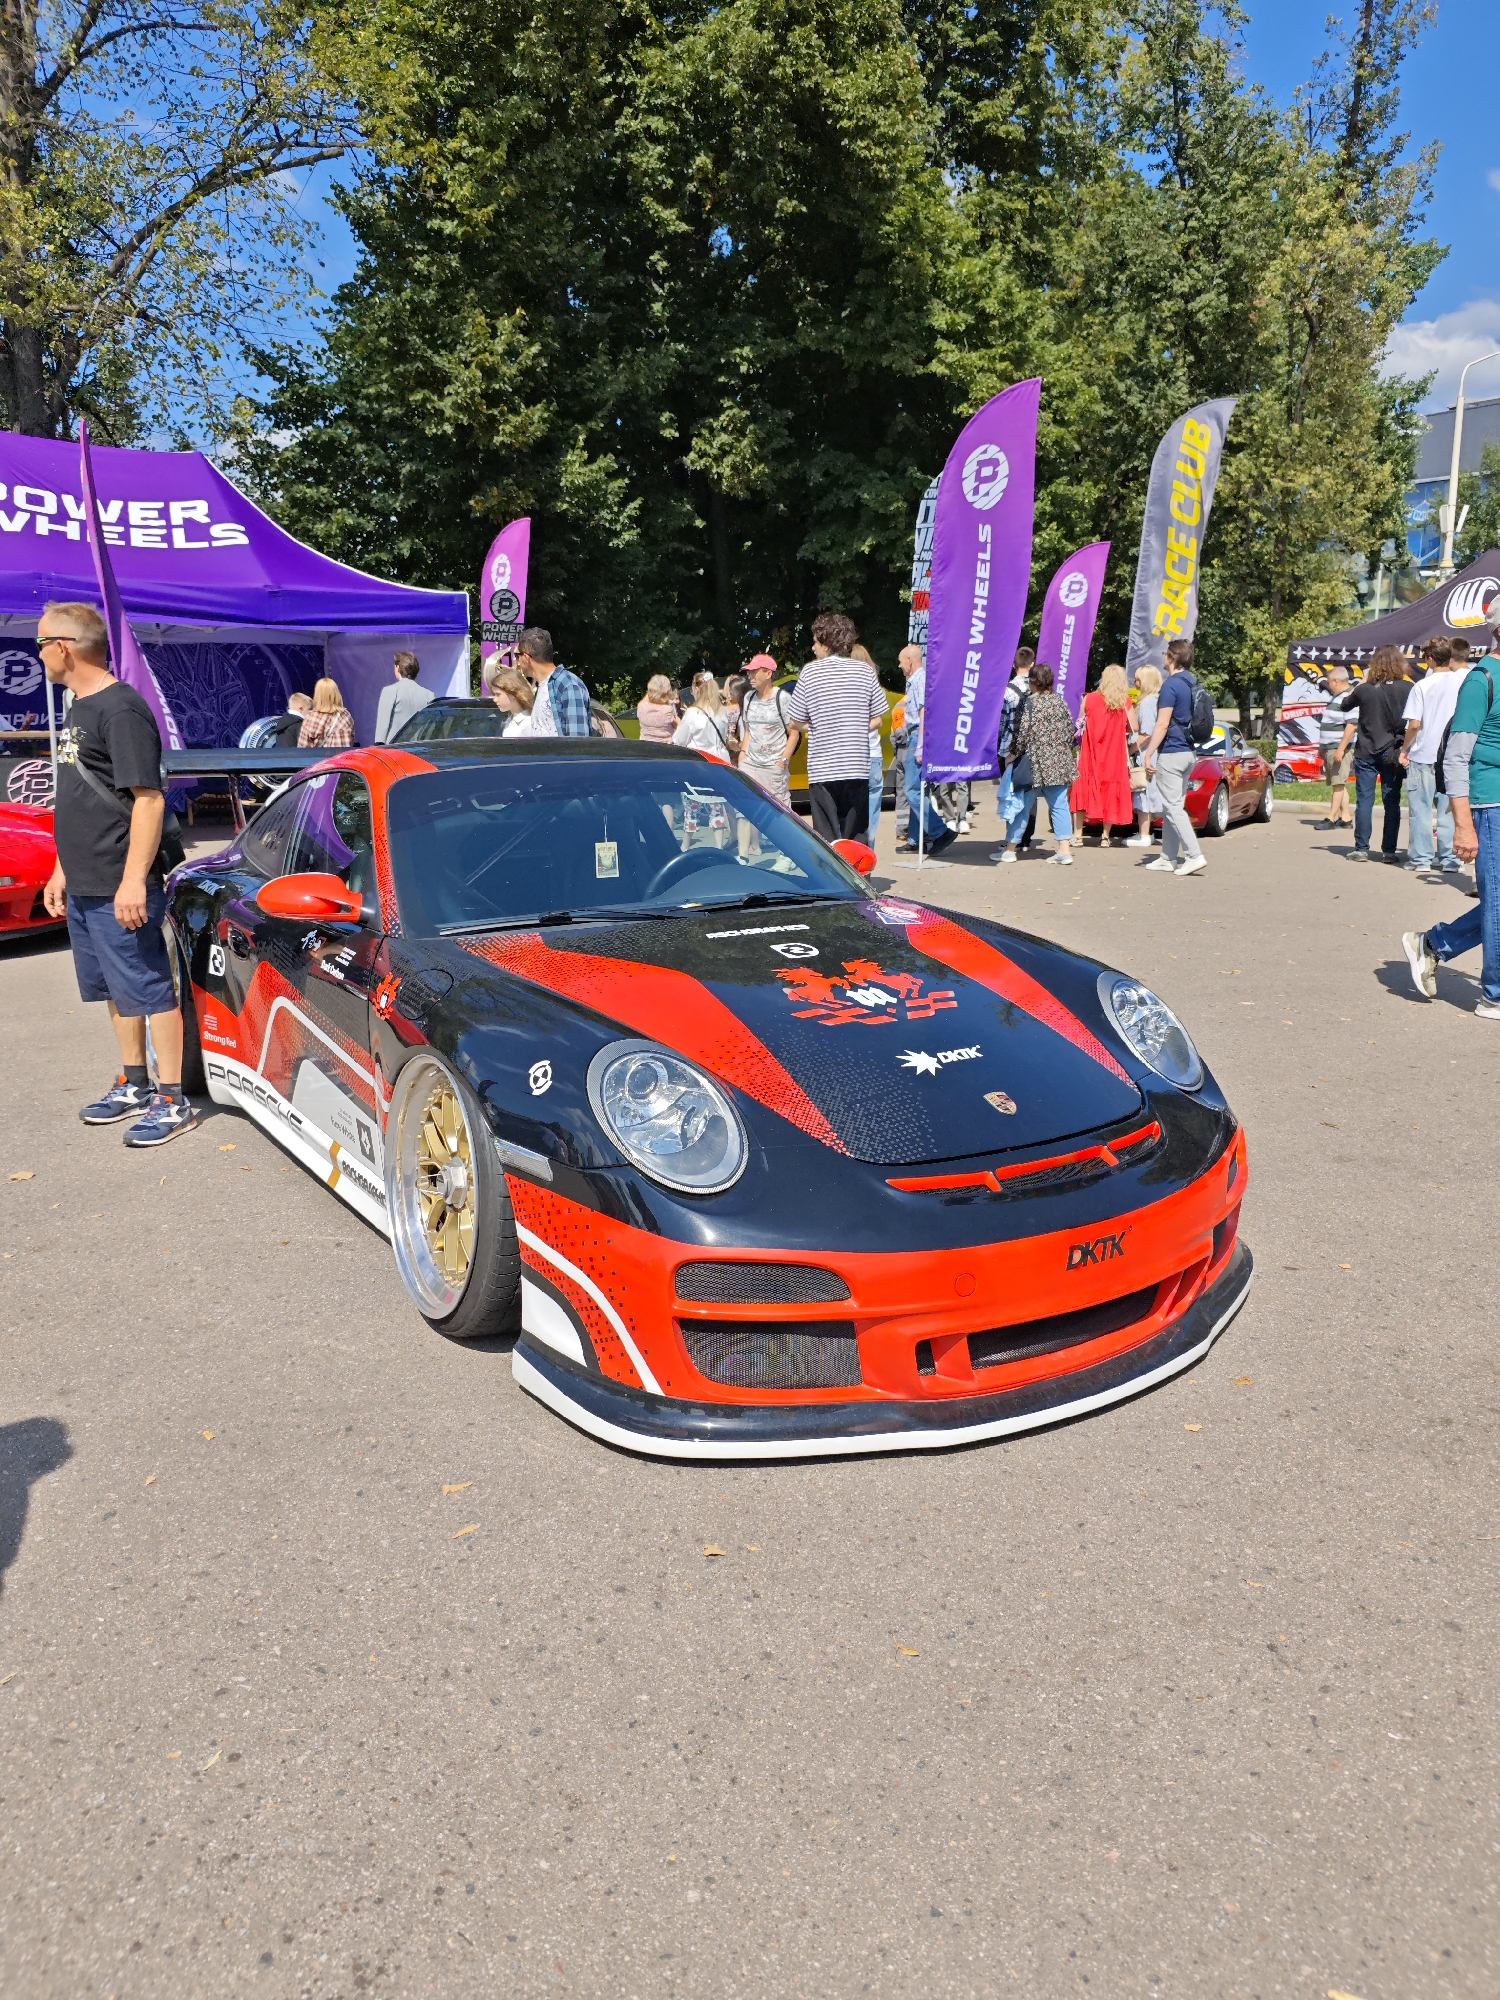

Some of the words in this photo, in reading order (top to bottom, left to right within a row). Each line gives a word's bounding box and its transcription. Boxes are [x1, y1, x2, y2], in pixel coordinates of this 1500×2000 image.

[1169, 417, 1212, 526] CLUB
[0, 483, 211, 526] OWER
[1153, 526, 1198, 638] RACE
[482, 623, 526, 633] POWER
[482, 632, 520, 642] WHEE
[953, 650, 982, 754] POWER
[968, 523, 992, 646] WHEELS
[1057, 613, 1076, 681] WHEELS
[1282, 708, 1310, 720] DRIFT
[203, 1030, 226, 1046] Strong
[225, 1036, 237, 1049] Red
[936, 1046, 984, 1064] DKTK
[207, 1062, 304, 1140] PORSCHE
[1065, 1230, 1127, 1272] DKTK
